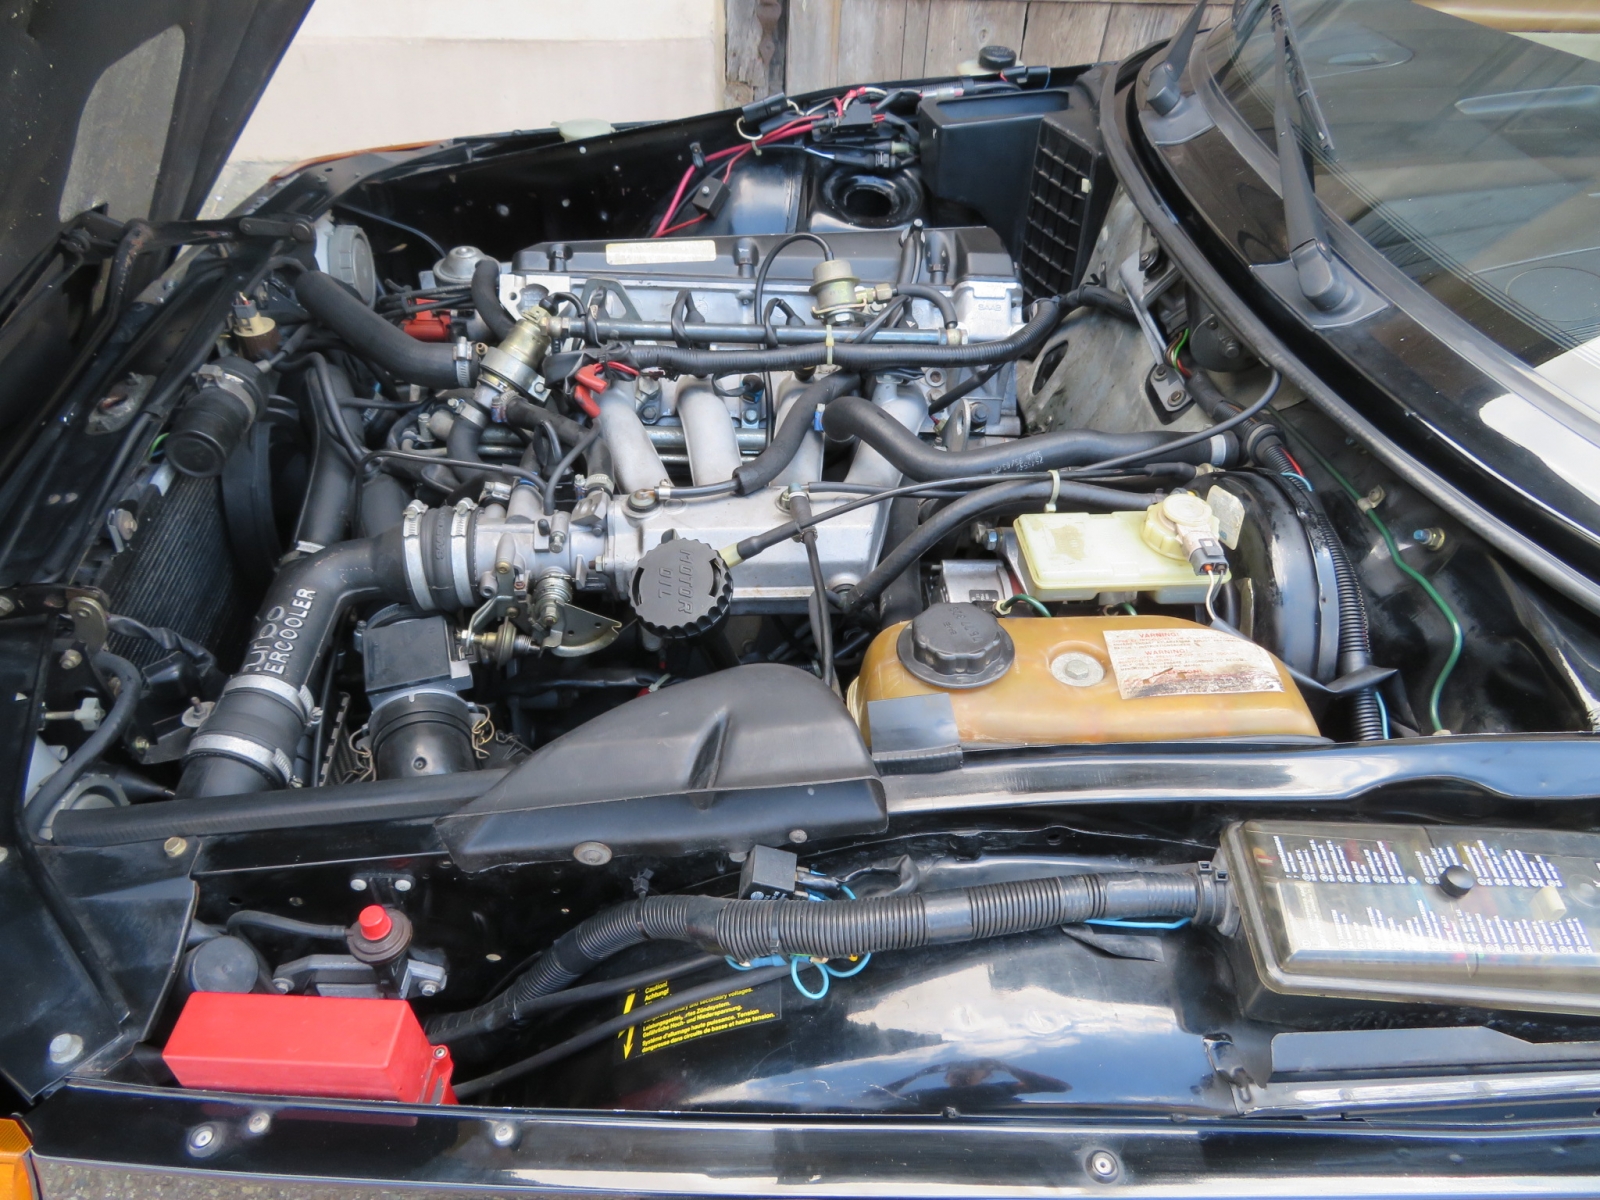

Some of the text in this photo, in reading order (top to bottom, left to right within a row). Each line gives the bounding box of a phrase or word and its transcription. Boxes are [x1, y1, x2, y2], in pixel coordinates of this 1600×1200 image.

[978, 303, 1001, 311] SAAB
[658, 567, 671, 599] OIL
[678, 549, 693, 614] MOTOR
[645, 981, 668, 994] Caution!
